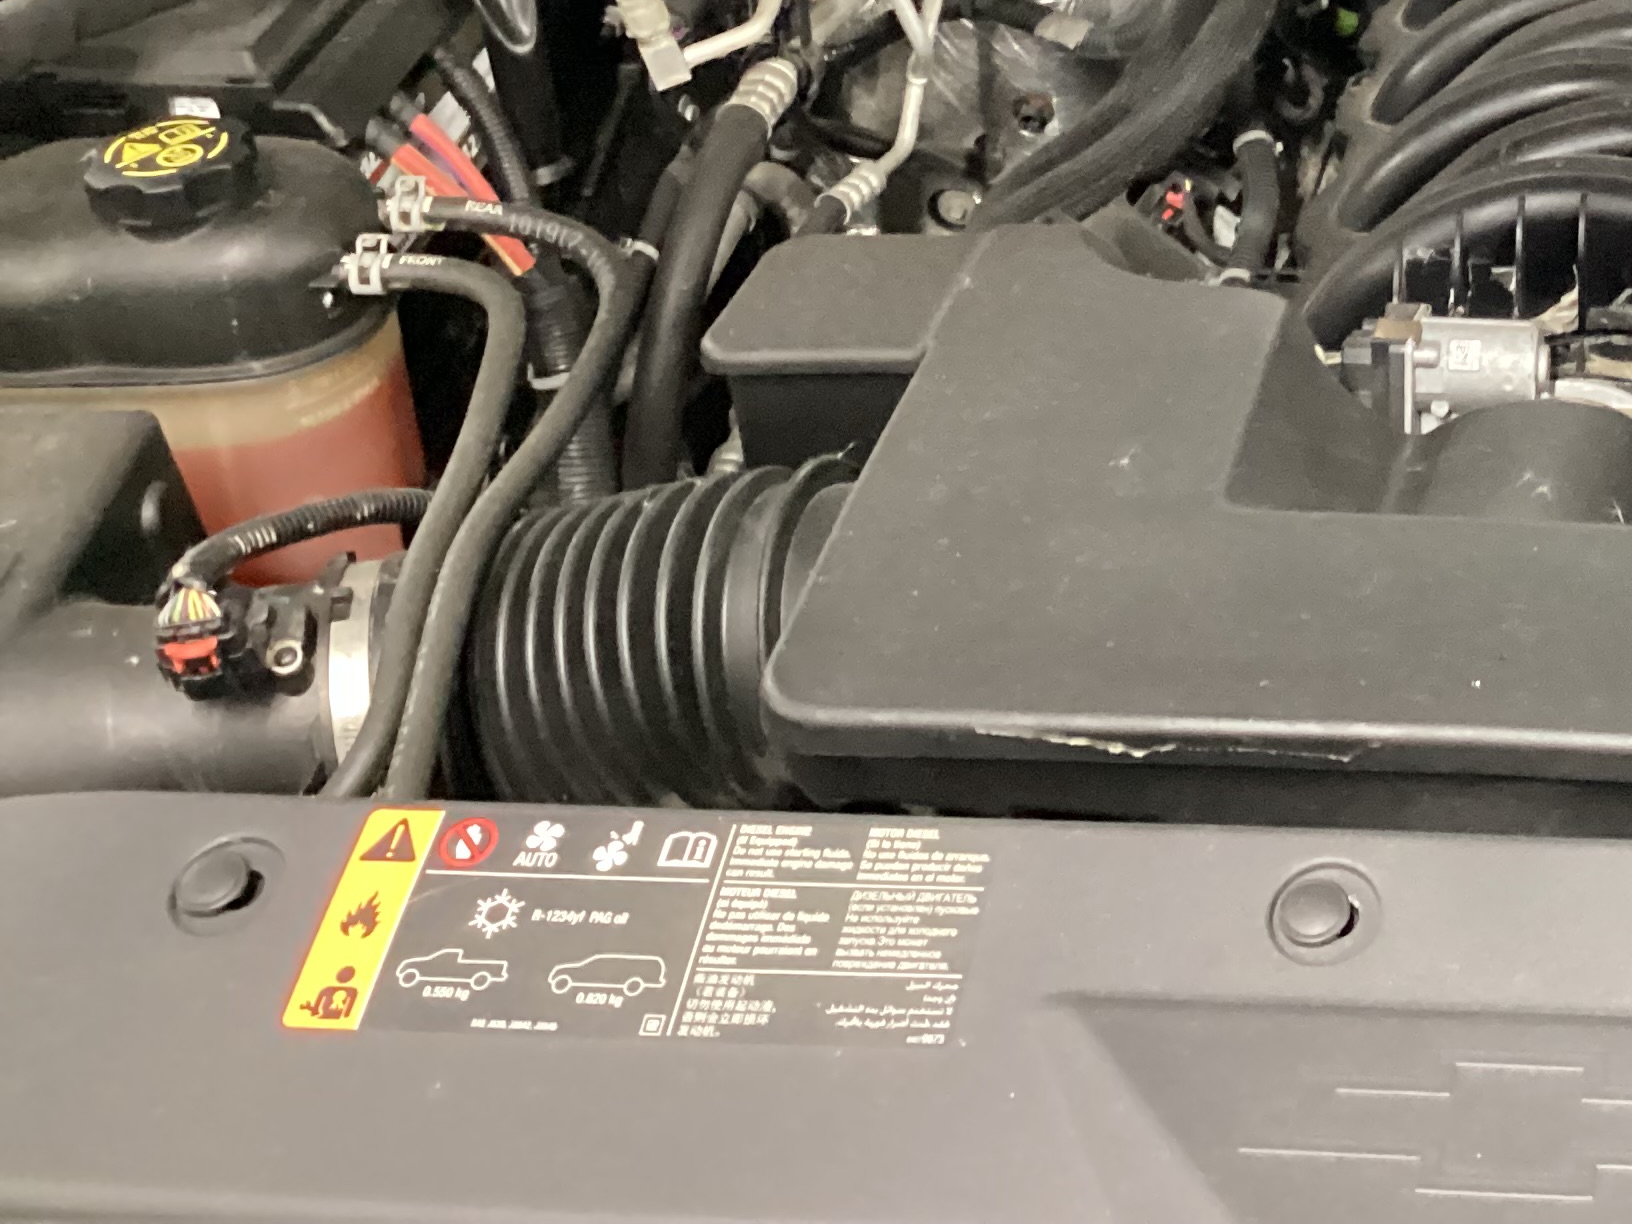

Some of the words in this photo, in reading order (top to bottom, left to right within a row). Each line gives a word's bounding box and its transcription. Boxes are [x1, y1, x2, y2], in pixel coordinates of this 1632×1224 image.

[398, 255, 445, 266] FRONT
[512, 852, 558, 868] AUTO
[916, 892, 977, 904] ДВИГАТЕЛЬ
[455, 987, 469, 1001] kg
[608, 994, 624, 1008] kg
